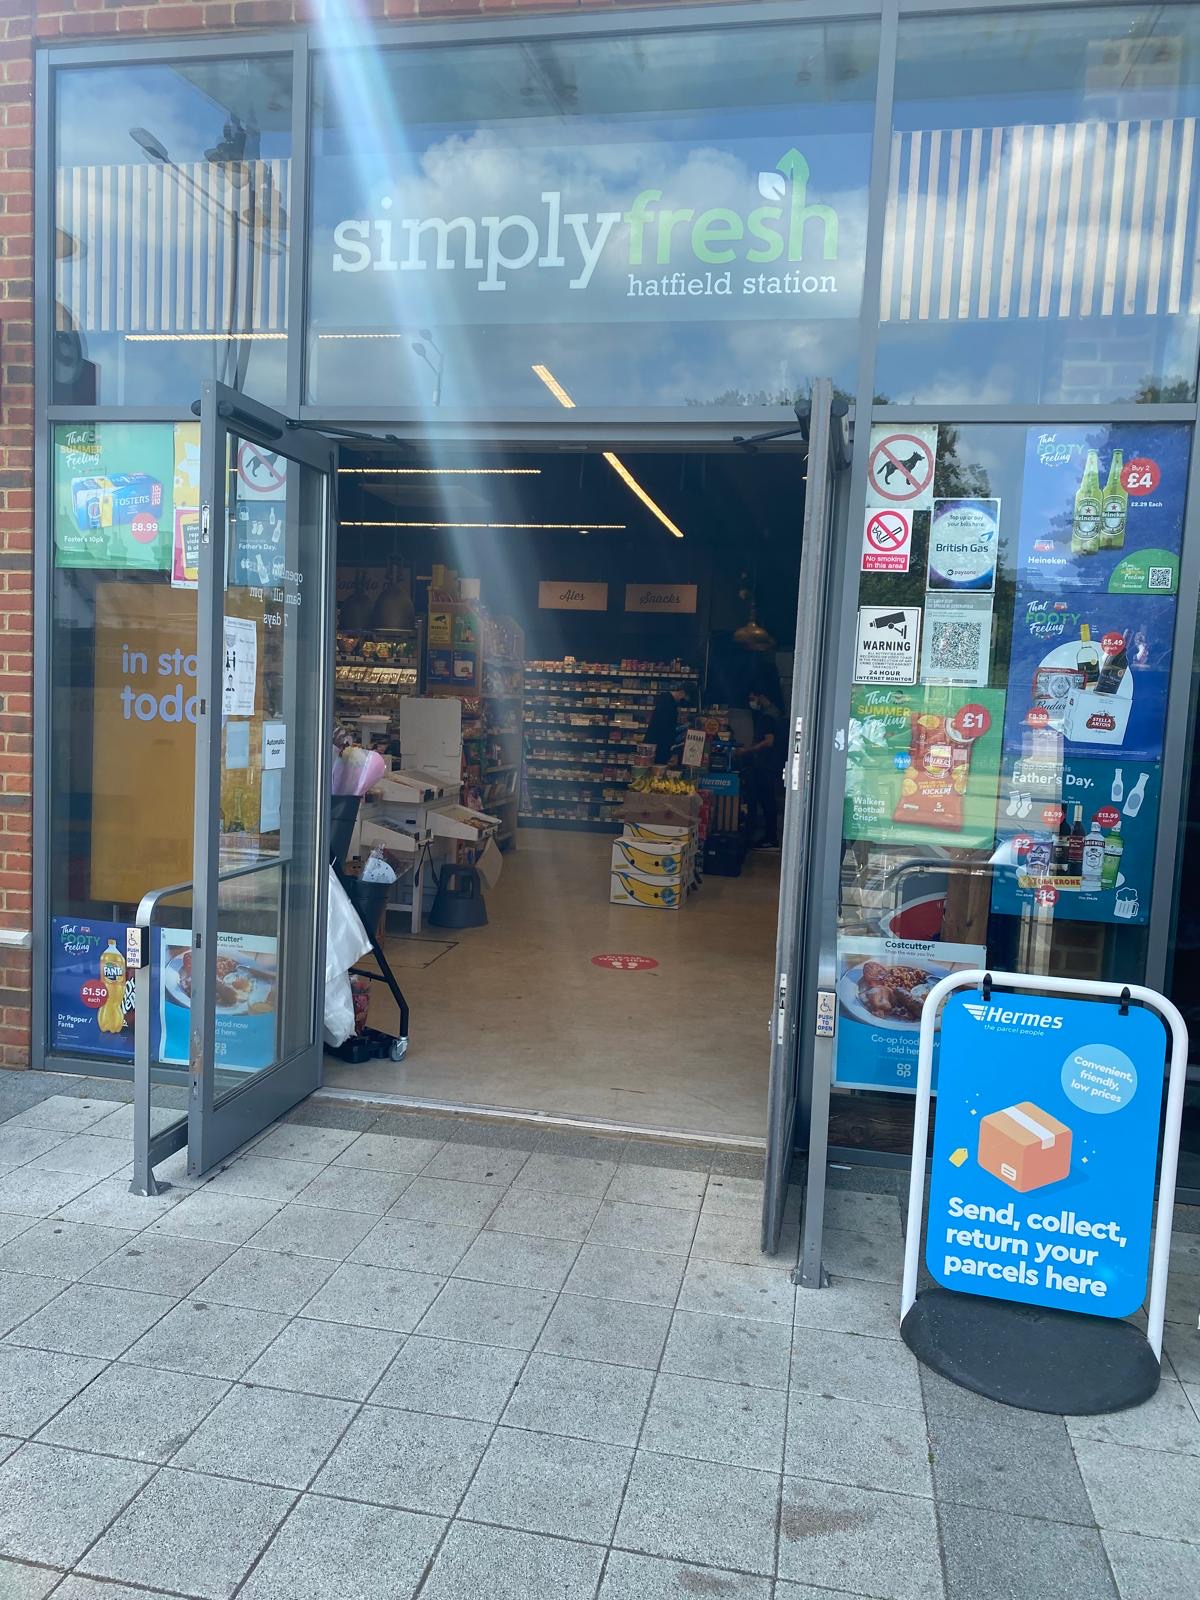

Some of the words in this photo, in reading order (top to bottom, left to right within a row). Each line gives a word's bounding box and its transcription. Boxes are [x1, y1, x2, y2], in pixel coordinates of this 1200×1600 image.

[627, 271, 732, 297] hatfield
[743, 269, 838, 295] station
[65, 431, 85, 445] That
[1038, 433, 1057, 444] That
[61, 445, 102, 454] SUMMER
[1037, 444, 1085, 455] FOOTY
[66, 452, 100, 467] Feeling
[1040, 451, 1071, 464] Feeling
[1127, 472, 1152, 488] £4
[132, 523, 158, 532] £8.99
[64, 535, 88, 543] Foster's
[936, 543, 968, 552] British
[970, 544, 989, 553] Gas
[1028, 556, 1067, 565] Heineken
[559, 589, 586, 602] Ales
[640, 591, 681, 604] Snacks
[1027, 600, 1048, 613] That
[1025, 613, 1080, 625] FOOTY
[1029, 623, 1065, 635] Feeling
[863, 641, 911, 651] WARNING
[122, 643, 148, 674] in
[158, 647, 198, 677] sto
[120, 683, 198, 723] toda
[865, 691, 891, 706] That
[857, 705, 911, 717] SUMMER
[962, 713, 983, 729] £1
[266, 738, 285, 747] Automatic
[271, 748, 280, 756] door
[702, 777, 731, 786] Hermes
[1012, 771, 1063, 784] Father's
[1066, 774, 1094, 789] Day.
[854, 797, 885, 806] Walkers
[853, 805, 885, 814] Football
[852, 813, 878, 822] Crisps
[1015, 839, 1030, 849] £2
[61, 924, 76, 935] That
[60, 933, 100, 947] FOOTY
[63, 941, 90, 953] Feeling
[82, 987, 107, 997] £1.50
[57, 1020, 75, 1029] Fanta
[58, 1013, 65, 1022] Dr
[66, 1014, 87, 1024] Pepper
[986, 1007, 1063, 1030] Hermes
[996, 1025, 1019, 1036] parcel
[1020, 1028, 1045, 1037] people
[871, 1034, 898, 1046] Co-op
[899, 1035, 919, 1046] food
[887, 1045, 904, 1054] sold
[906, 1046, 920, 1055] her
[1074, 1055, 1133, 1084] Convenient,
[1080, 1069, 1120, 1092] friendly,
[1071, 1078, 1090, 1094] low
[1090, 1085, 1122, 1104] prices
[948, 1196, 1021, 1231] Send,
[1027, 1210, 1127, 1248] collect,
[946, 1227, 1029, 1256] return
[1034, 1241, 1099, 1267] your
[943, 1253, 1039, 1287] parcels
[1046, 1266, 1107, 1298] here
